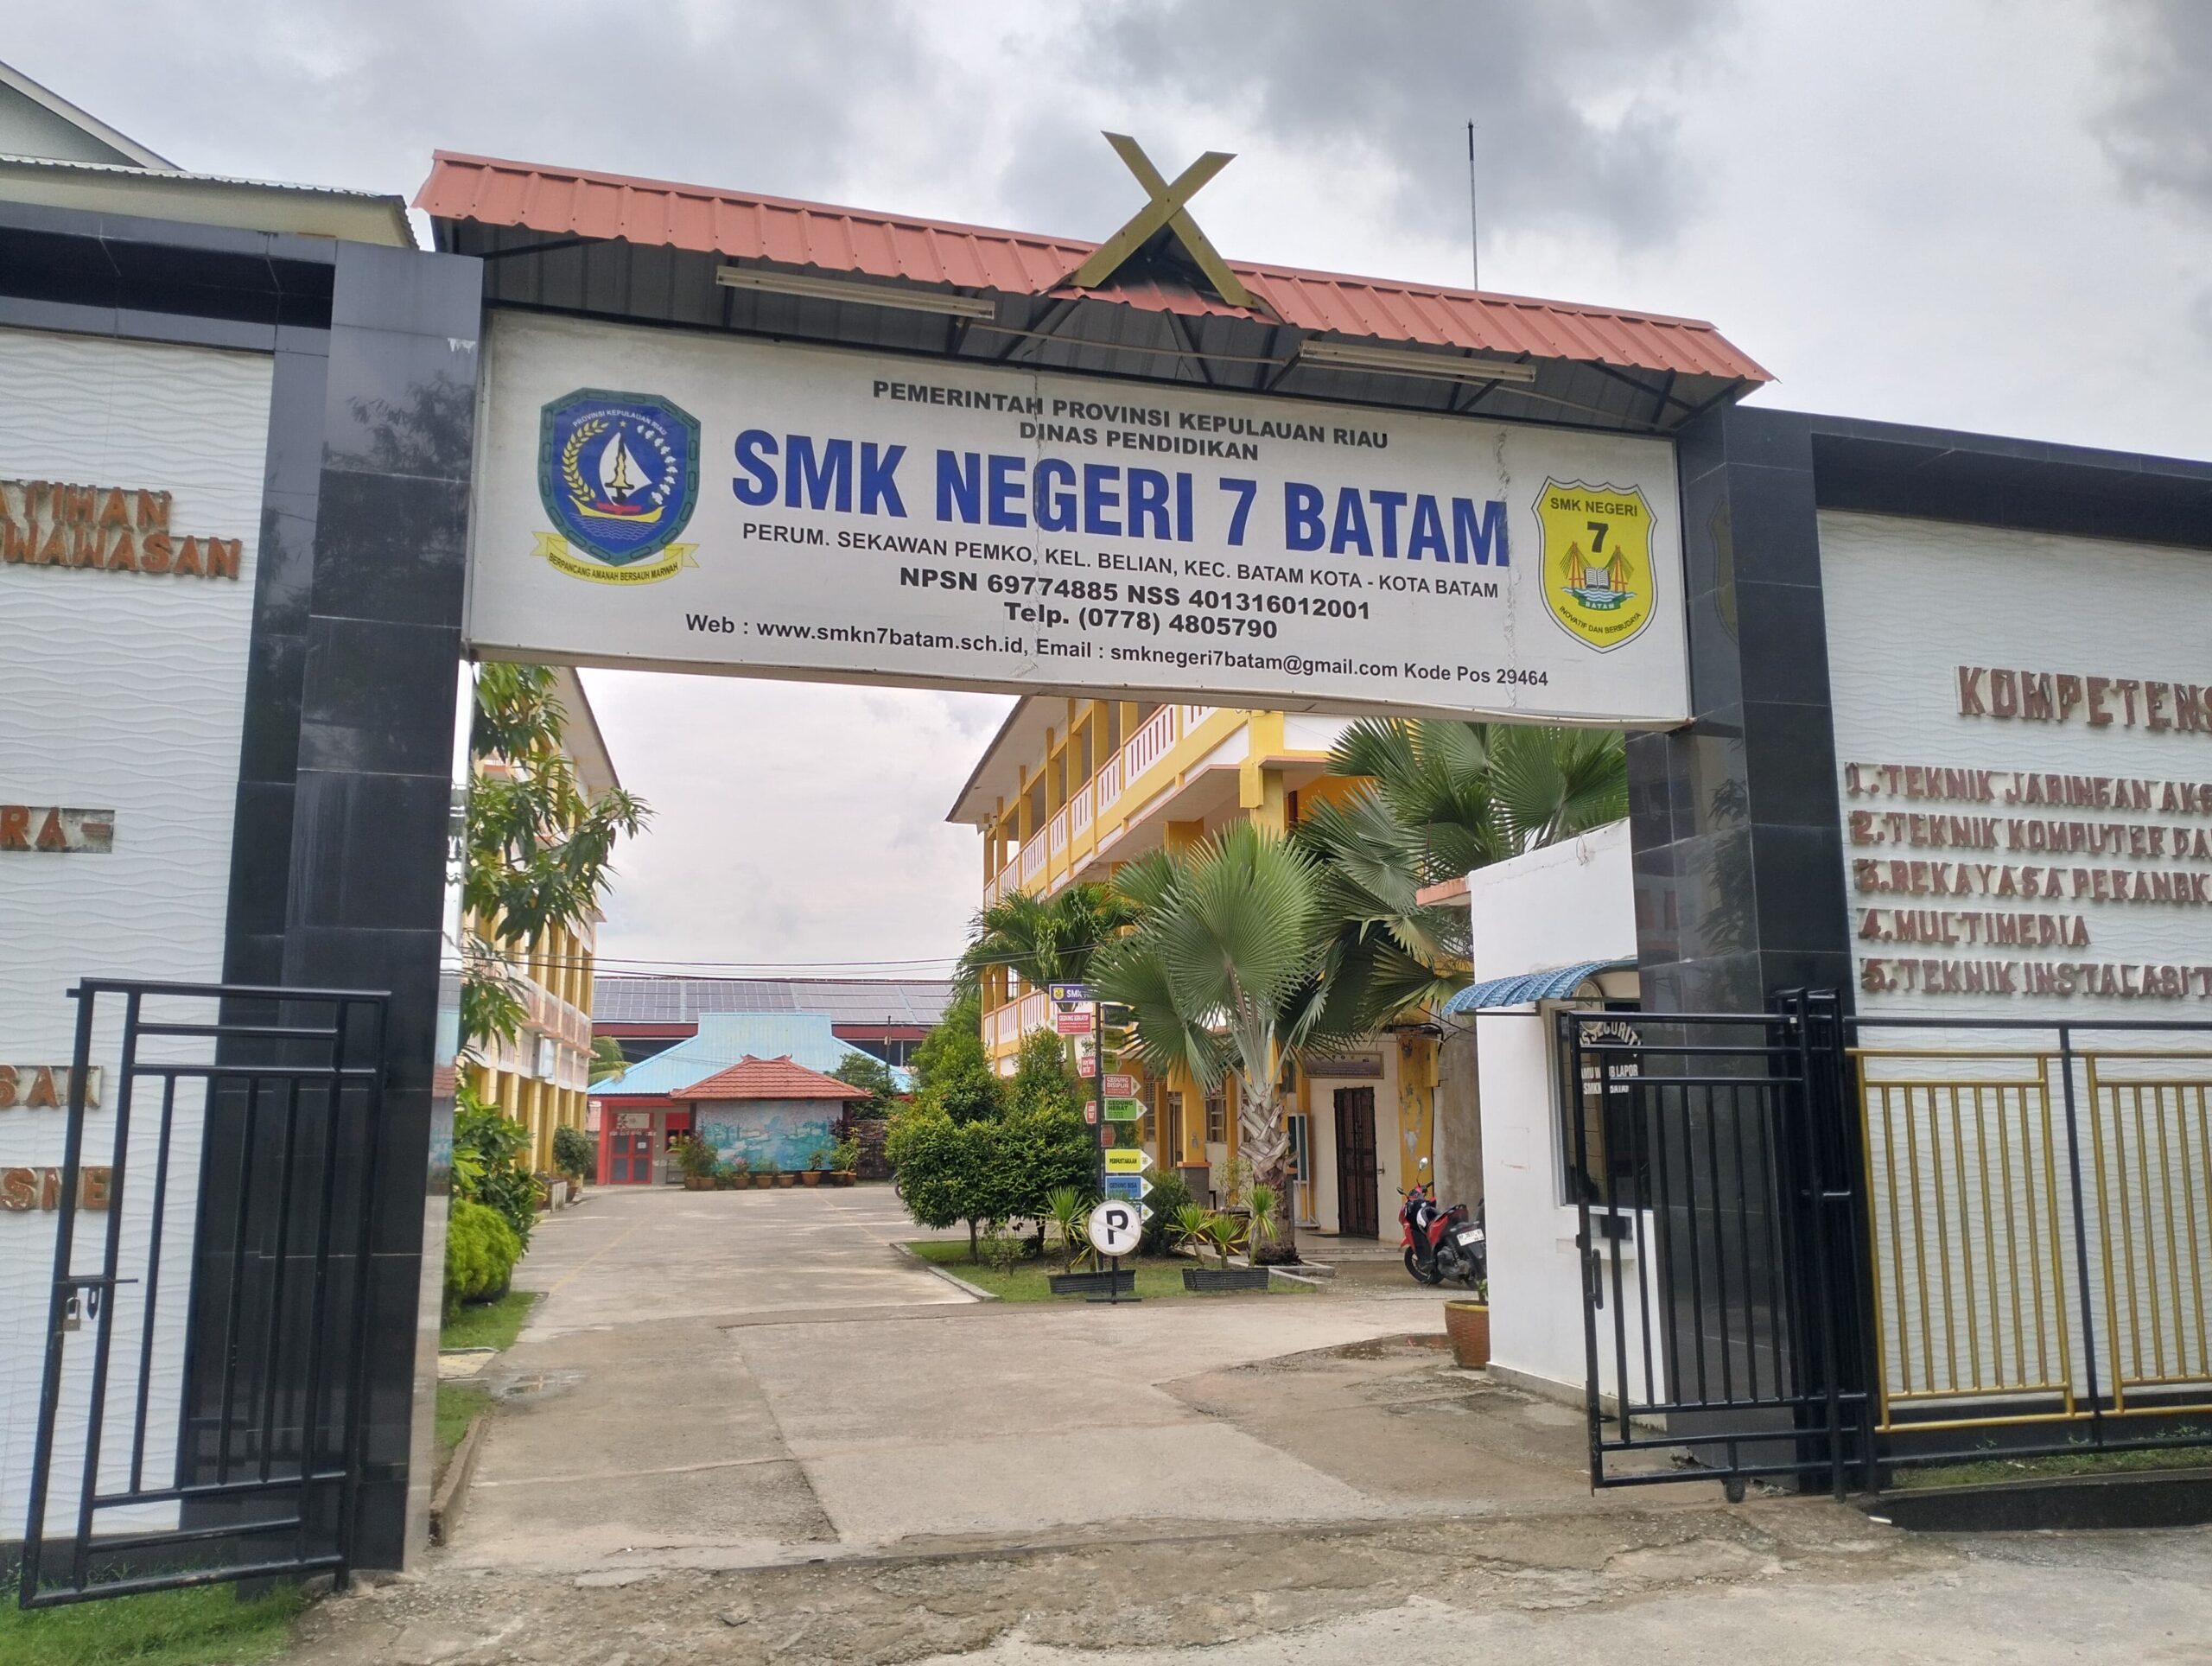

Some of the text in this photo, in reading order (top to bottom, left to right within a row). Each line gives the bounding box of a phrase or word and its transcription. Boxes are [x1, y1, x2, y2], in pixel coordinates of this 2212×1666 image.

[572, 410, 668, 436] PROVINSI KEPULAUAN RIAU
[873, 380, 1389, 449] PEMERINTAH PROVINSI KEPULAUAN RIAU
[1020, 422, 1258, 461] DINAS PENDIDIKAN
[732, 429, 1510, 568] SMK NEGERI 7 BATAM
[1550, 497, 1637, 517] SMK NEGERI
[1586, 521, 1609, 553] 7
[592, 569, 620, 581] AMANAH
[620, 569, 650, 582] BERSAUH
[650, 562, 679, 580] MARWAH
[742, 522, 830, 546] PERUM.
[837, 531, 948, 556] SEKAWAN
[955, 541, 1037, 565] PEMKO,
[1045, 548, 1091, 568] KEL.
[1097, 553, 1178, 576] BELIAN,
[1184, 560, 1231, 579] KEC.
[1237, 563, 1304, 583] BATAM
[1310, 569, 1363, 588] KOTA
[1378, 575, 1431, 594] KOTA
[1435, 579, 1499, 598] BATAM
[899, 567, 1370, 620] NPSN 69774885 NSS 401316012001
[1004, 602, 1278, 639] Telp. (0778) 4805790
[1559, 605, 1642, 634] INOVATIF DAN BERBUDAYA
[685, 613, 735, 634] Web
[756, 622, 1028, 657] www.smkn7batam.sch.id,
[1037, 638, 1091, 658] Email
[1110, 645, 1398, 677] smknegeri7batam@gmail.com
[1403, 662, 1452, 681] Kode
[1457, 666, 1491, 684] Pos
[1496, 668, 1549, 686] 29464
[2003, 773, 2152, 808] JARINGAN
[2006, 818, 2165, 855] KOMPUTER
[2172, 826, 2212, 857] DA
[2023, 962, 2191, 996] INSTALASI
[1616, 1064, 1638, 1078] LAPOR
[1106, 1210, 1128, 1244] P
